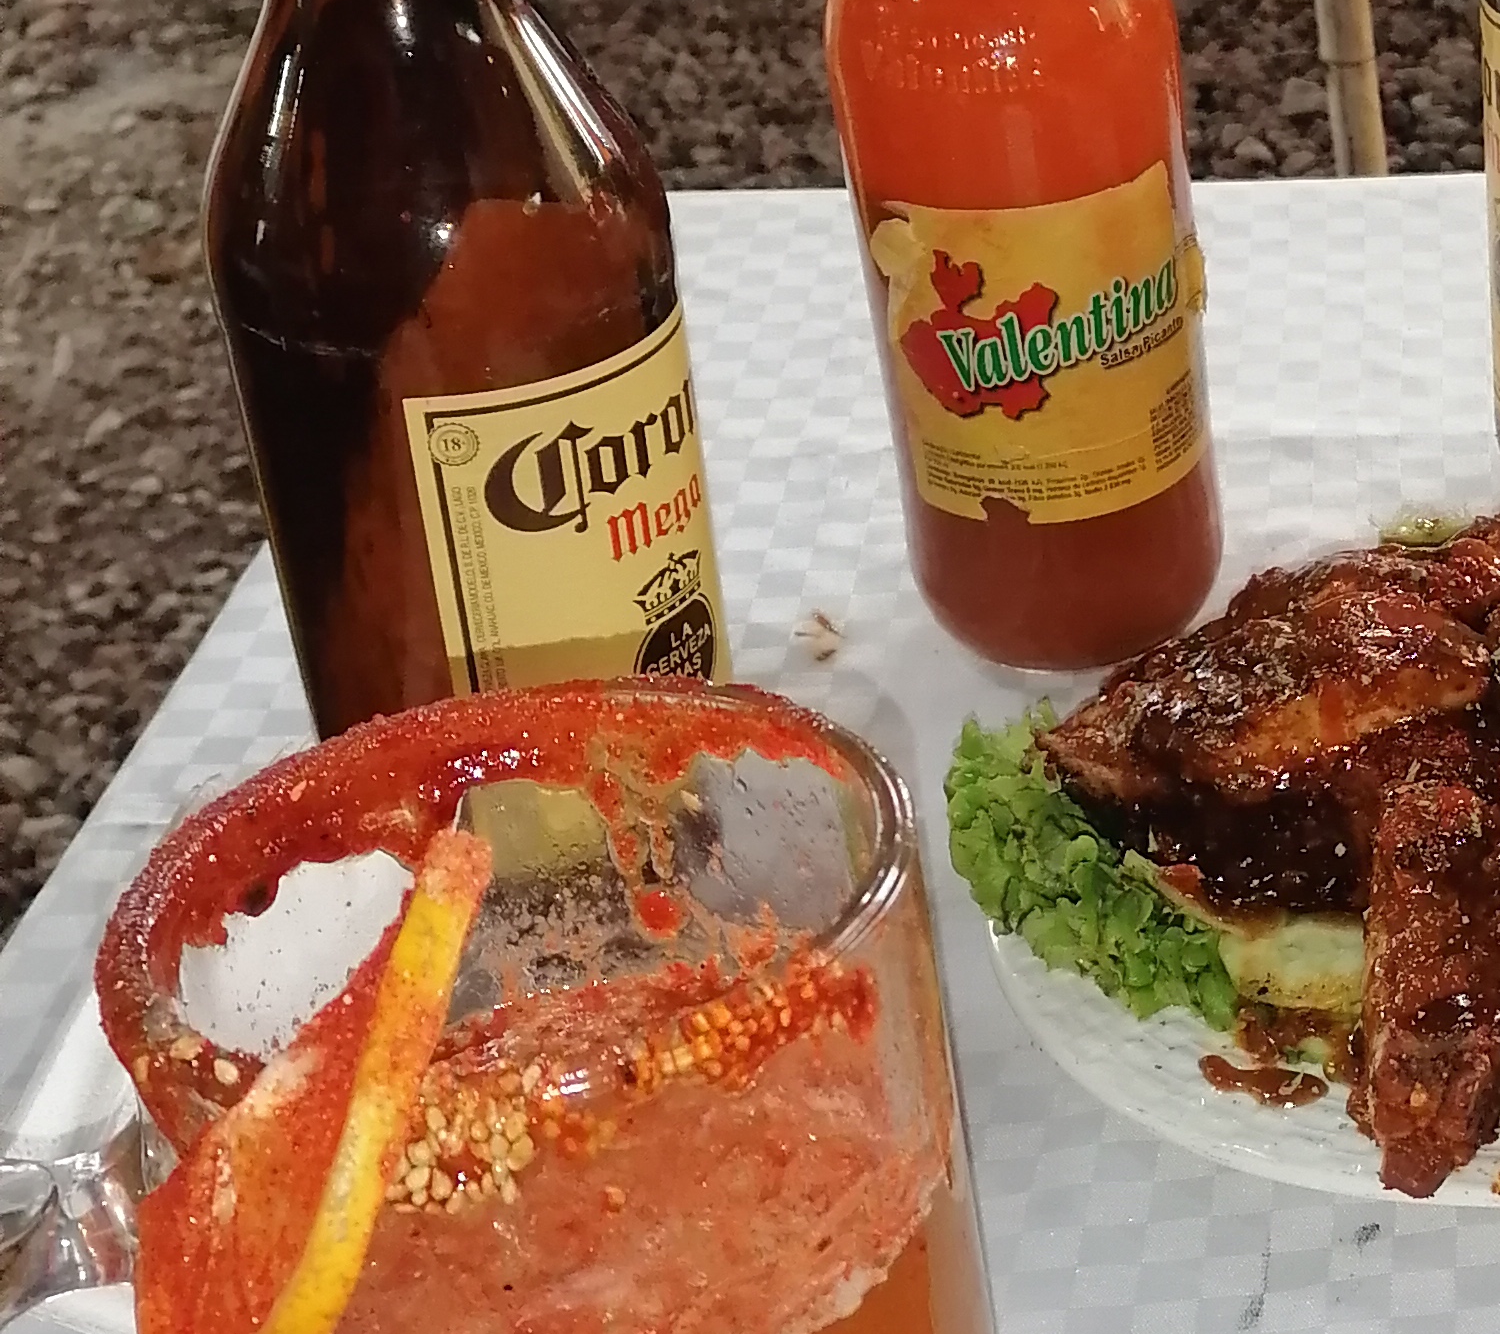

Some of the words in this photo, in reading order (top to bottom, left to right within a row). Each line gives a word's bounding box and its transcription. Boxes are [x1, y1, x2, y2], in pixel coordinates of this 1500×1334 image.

[938, 255, 1177, 391] Valentina
[1100, 344, 1140, 366] Salsa
[607, 473, 701, 562] Mega
[646, 623, 711, 678] CERVEZA
[670, 621, 693, 648] LA
